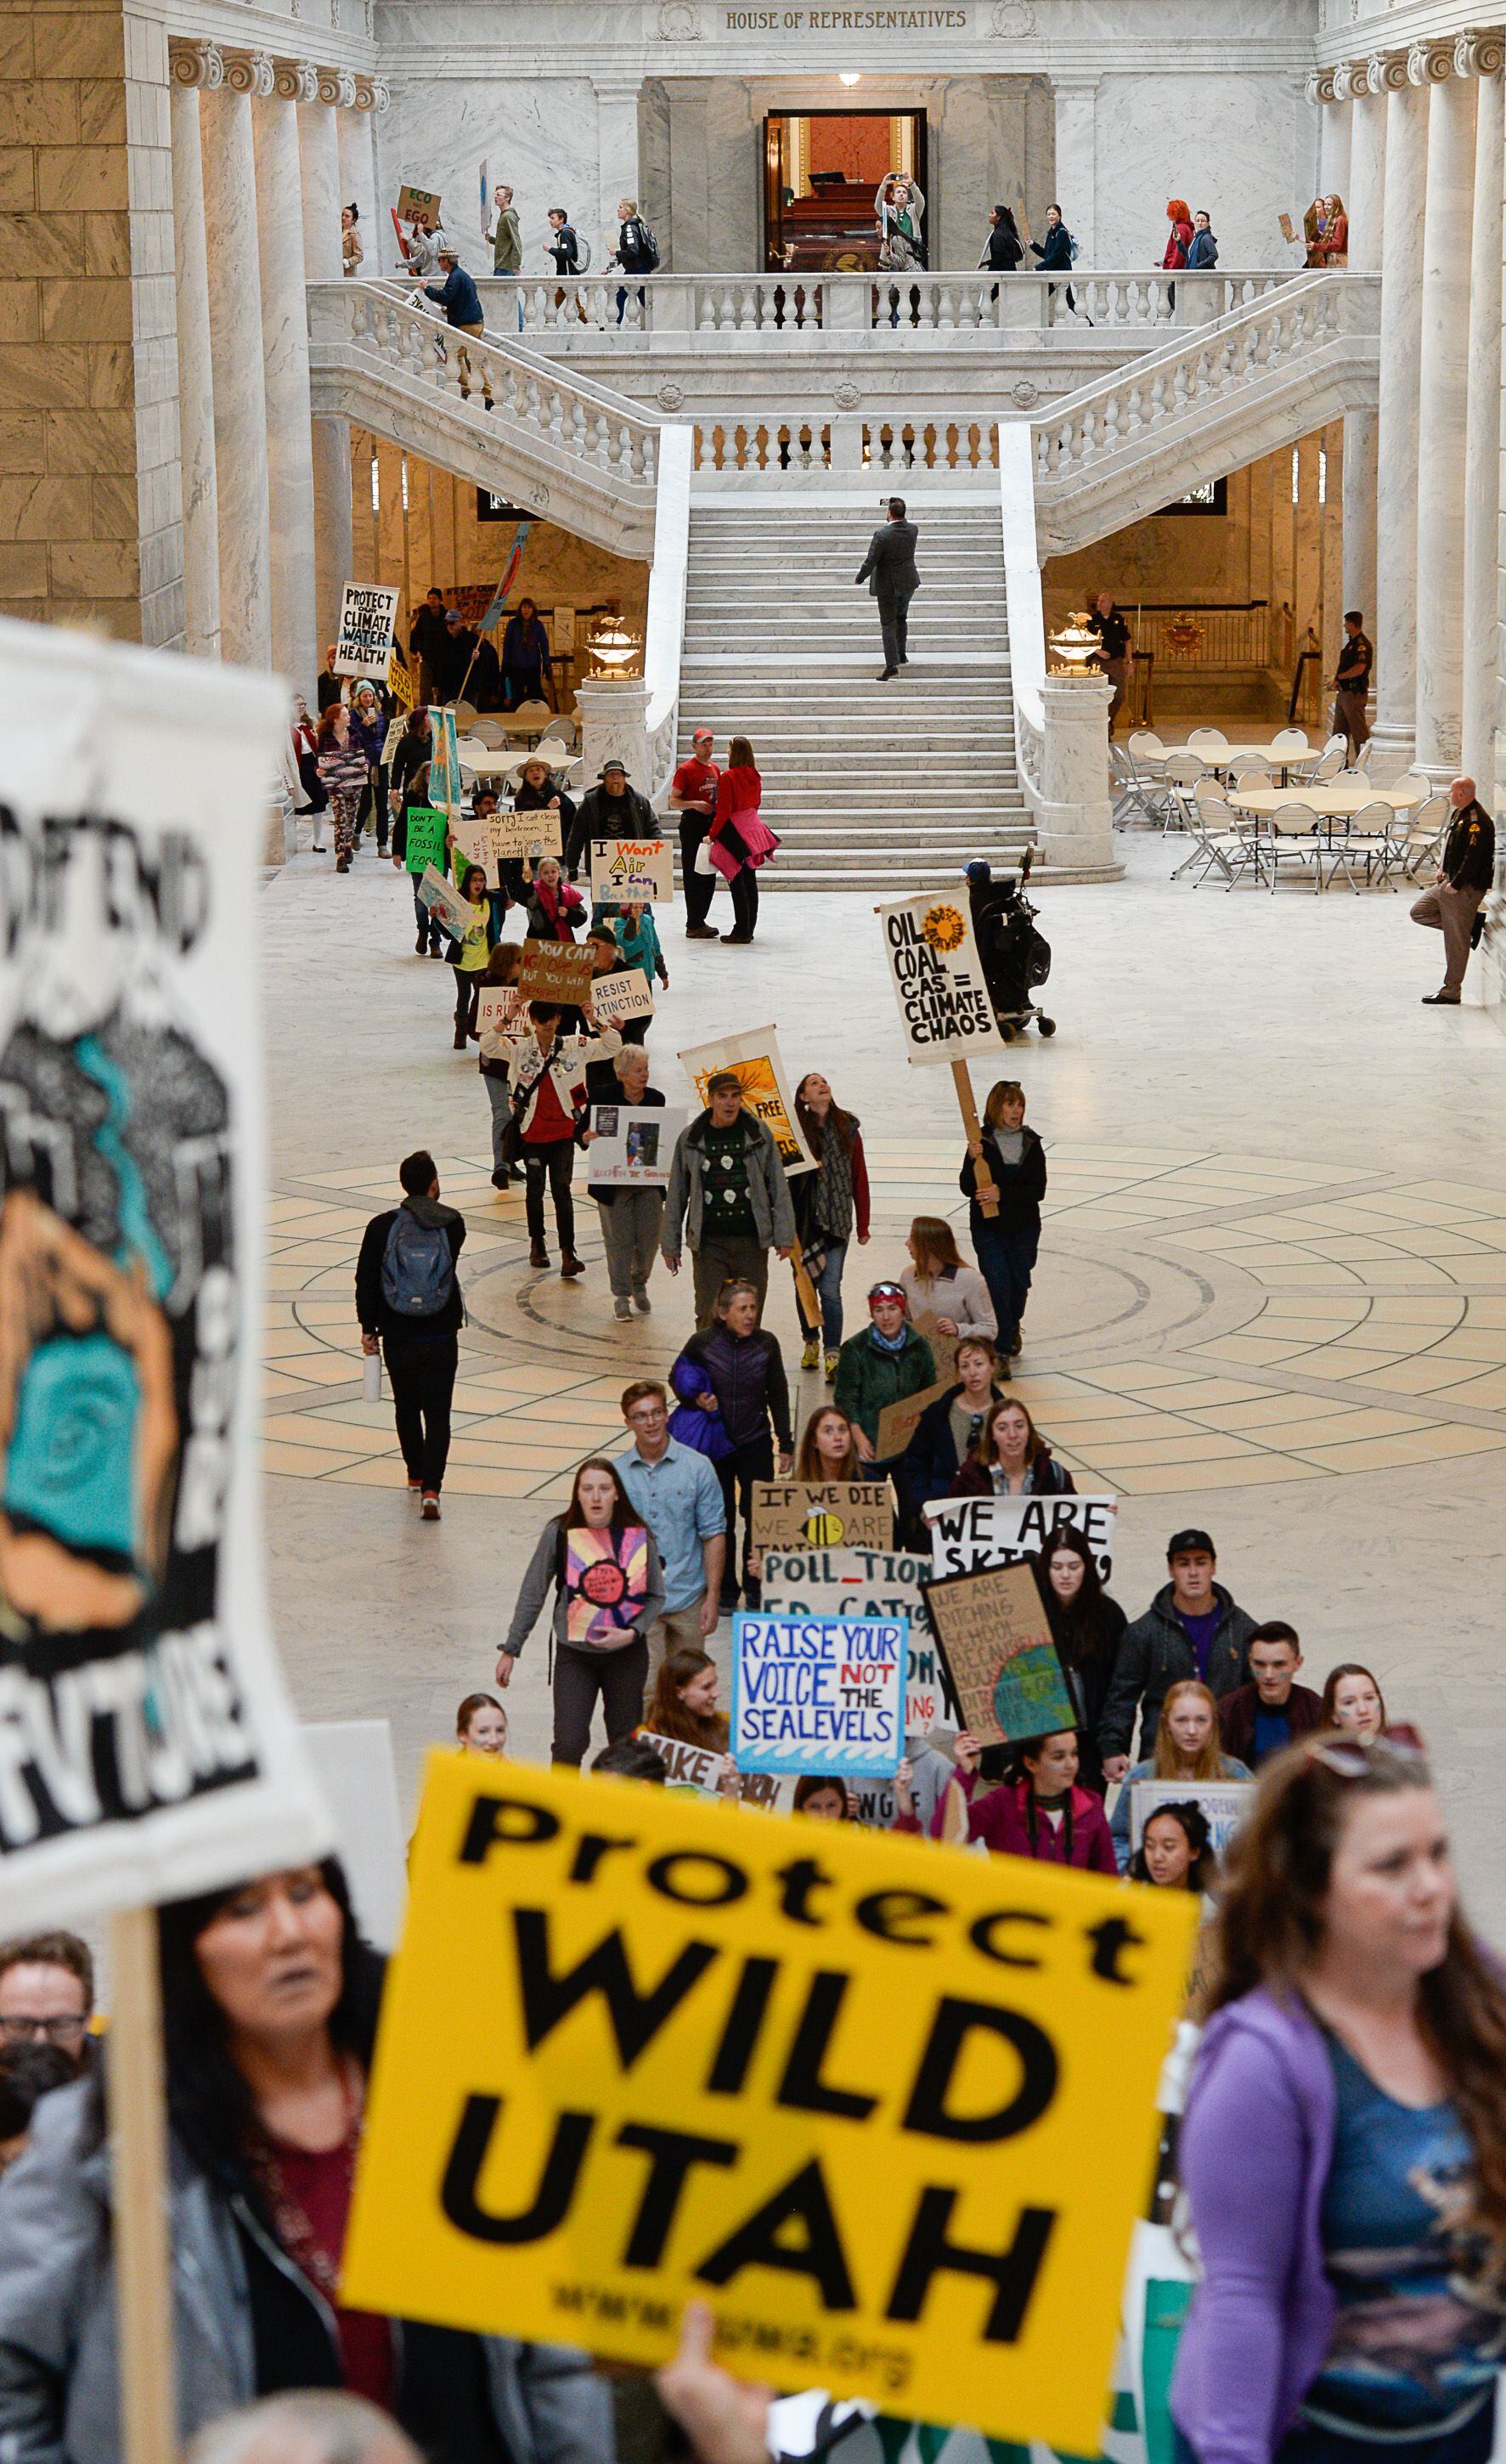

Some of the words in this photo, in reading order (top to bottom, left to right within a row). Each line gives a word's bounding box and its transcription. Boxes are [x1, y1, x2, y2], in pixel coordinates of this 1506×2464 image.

[726, 12, 778, 29] HOUSE
[784, 12, 802, 29] OF
[809, 11, 967, 28] REPRESENTATIVES
[409, 189, 431, 204] ECO
[404, 209, 429, 224] EGO
[346, 588, 393, 610] PROTECT
[344, 611, 391, 632] CLIMATE
[343, 626, 387, 646] WATER
[339, 644, 386, 665] HEALTH
[391, 675, 412, 702] UTAH
[490, 827, 501, 837] my
[544, 823, 553, 833] I
[409, 839, 441, 851] FOSSIL
[492, 839, 510, 847] have
[513, 837, 523, 846] to
[593, 841, 607, 856] I
[617, 840, 664, 856] Want
[609, 856, 646, 873] Air
[612, 874, 623, 885] I
[538, 941, 563, 957] YOU
[522, 969, 539, 981] BUT
[545, 972, 562, 984] YOU
[595, 981, 632, 1000] RESIST
[900, 975, 947, 999] GAS
[482, 1004, 492, 1017] IS
[905, 990, 987, 1023] CLIMATE
[911, 1012, 992, 1043] CHAOS
[760, 1489, 798, 1507] IF
[808, 1487, 839, 1504] WE
[849, 1486, 885, 1506] DIE
[754, 1519, 788, 1535] WE
[849, 1516, 889, 1535] ARE
[938, 1500, 995, 1542] WE
[968, 1574, 1010, 1601] ARE
[936, 1596, 1014, 1631] DITCHING
[742, 1624, 837, 1659] RAISE
[843, 1625, 899, 1661] YOUR
[743, 1662, 837, 1707] VOICE
[841, 1664, 894, 1685] NOT
[840, 1688, 883, 1708] THE
[456, 1794, 1148, 1988] Protect
[508, 1906, 1061, 2145] WILD
[437, 2092, 1058, 2346] UTAH
